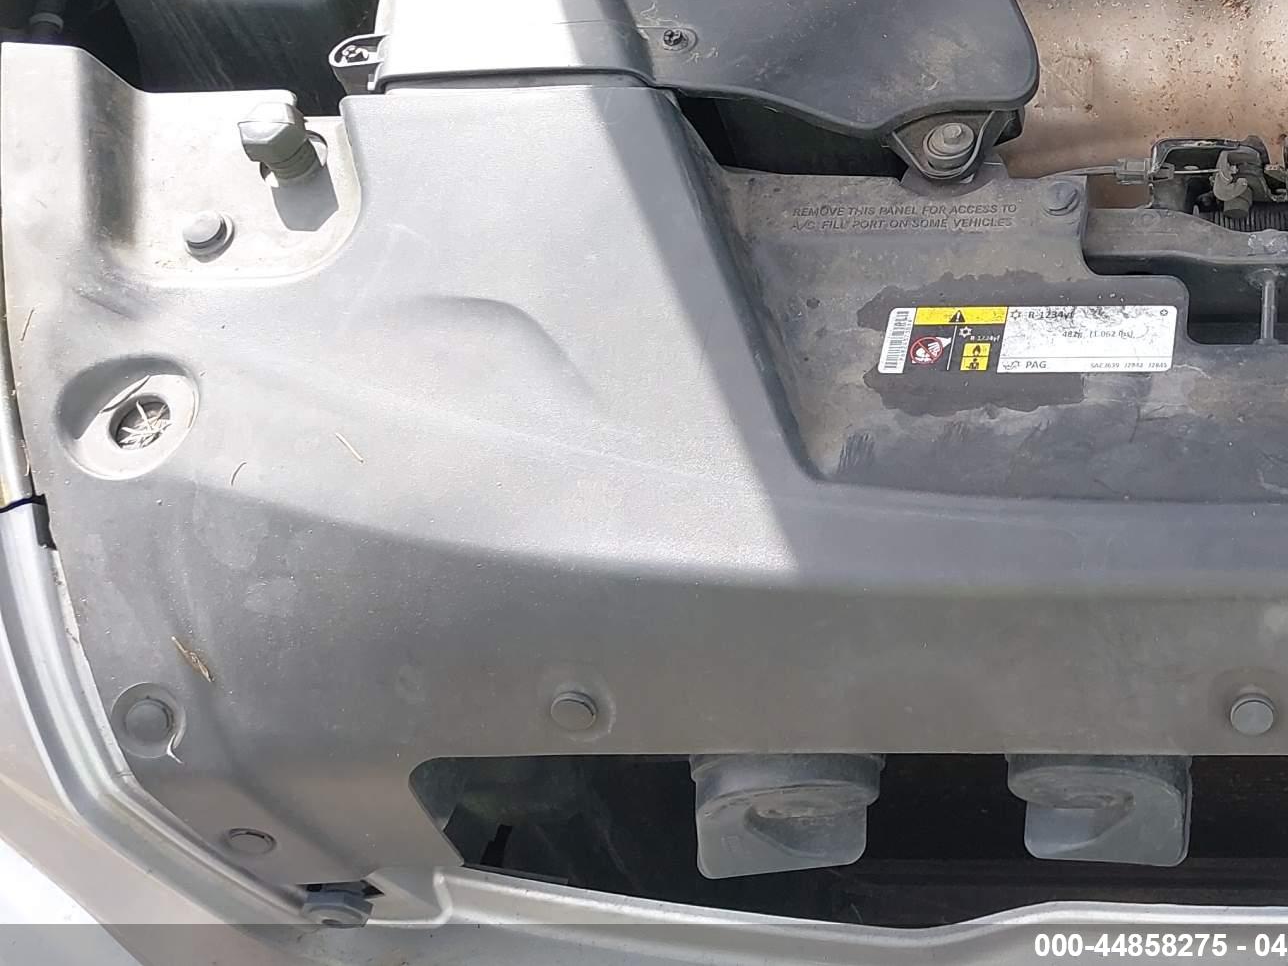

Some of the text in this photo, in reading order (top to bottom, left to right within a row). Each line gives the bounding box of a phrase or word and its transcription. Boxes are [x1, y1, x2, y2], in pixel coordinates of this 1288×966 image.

[792, 203, 1017, 217] REMOVE THIS PANEL FOR ACCESS TO
[821, 219, 846, 230] FILL
[852, 219, 886, 230] PORT
[889, 218, 909, 229] ON
[911, 218, 948, 229] SOME
[953, 217, 1013, 228] VEHICLES
[1025, 360, 1047, 369] PAG
